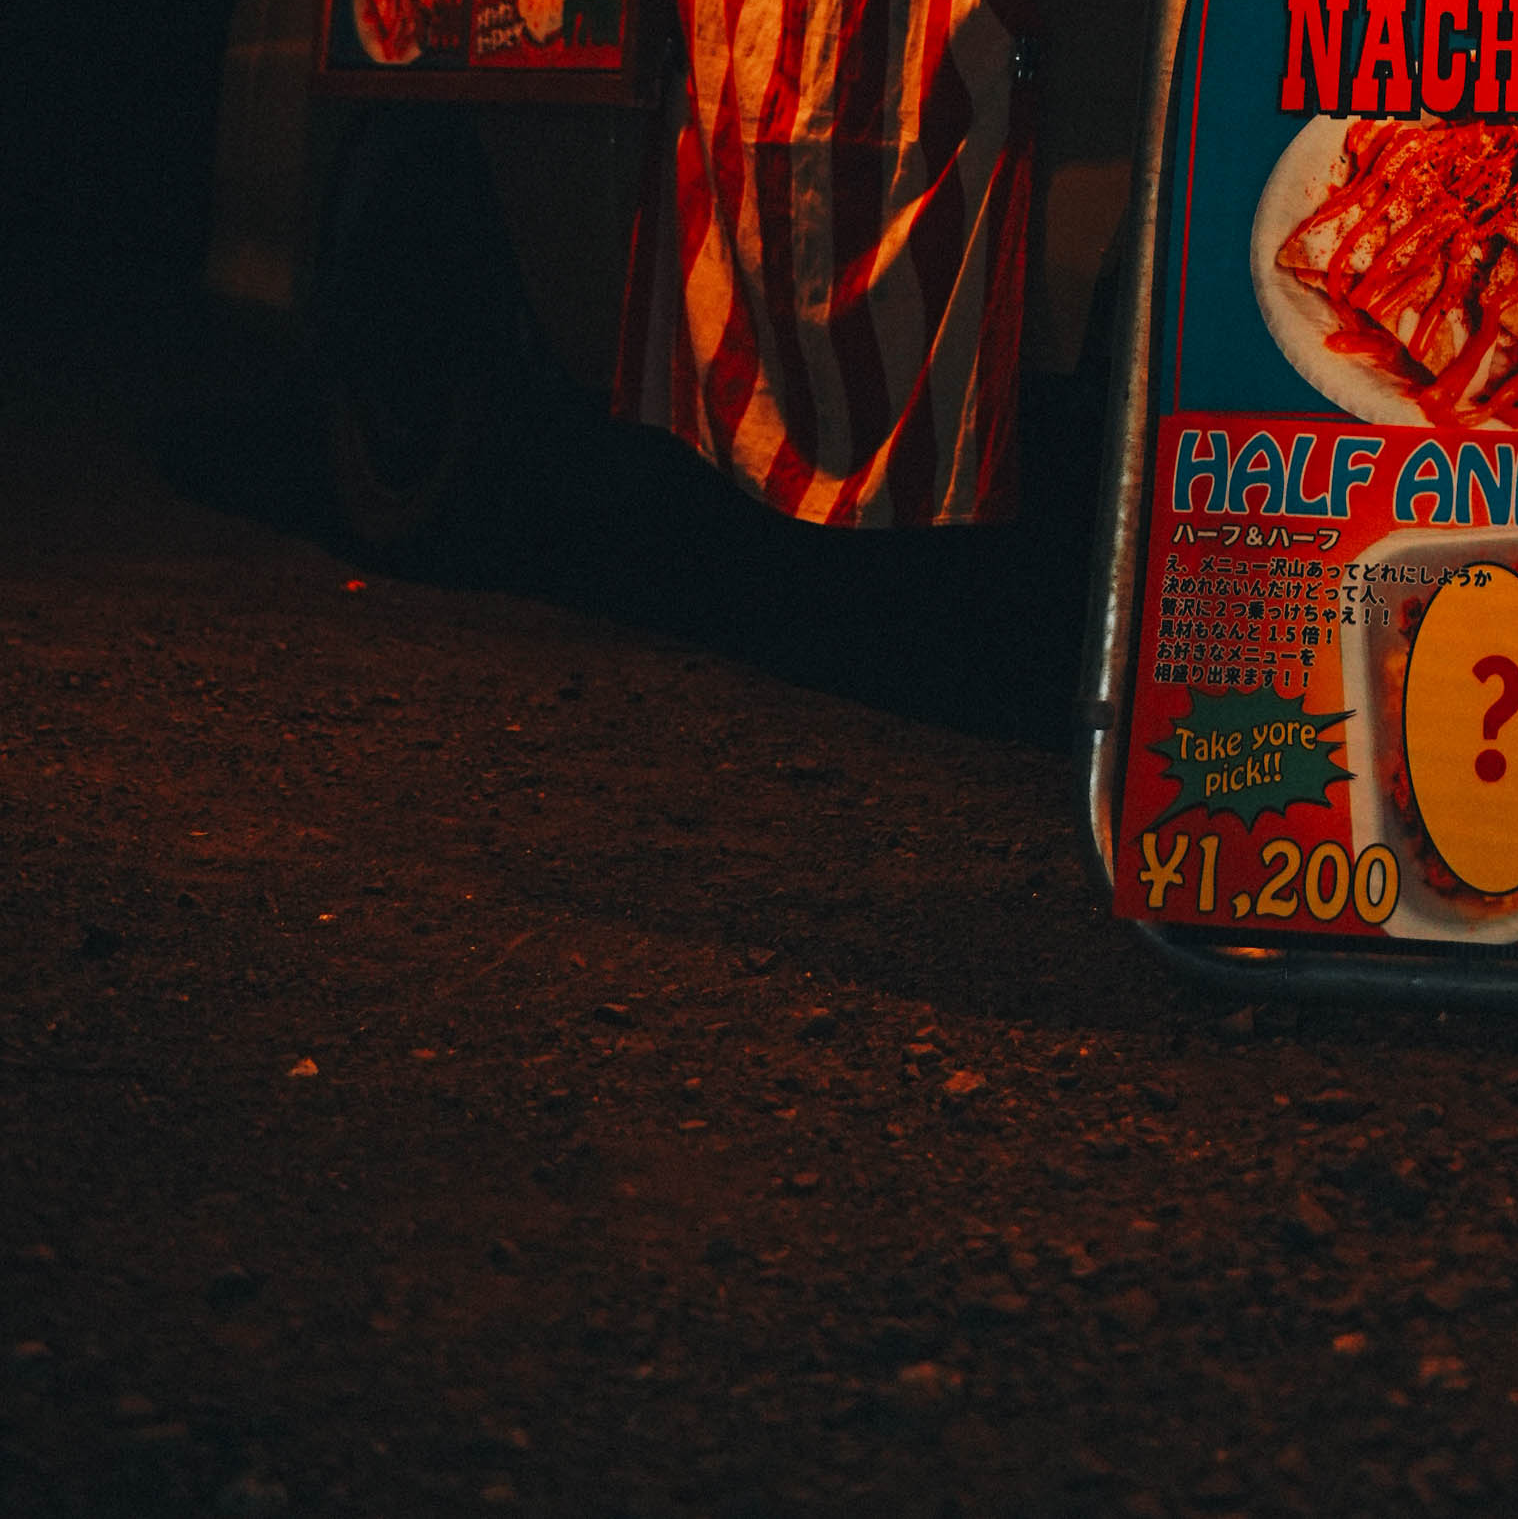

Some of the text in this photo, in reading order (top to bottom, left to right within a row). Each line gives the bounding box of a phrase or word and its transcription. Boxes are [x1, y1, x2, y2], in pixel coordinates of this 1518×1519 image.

[1173, 430, 1384, 518] HALF
[1156, 642, 1317, 666] お好きなメニューを
[1175, 718, 1318, 763] Take yore
[1203, 752, 1283, 798] pick!!
[1139, 832, 1400, 925] ¥1,200
